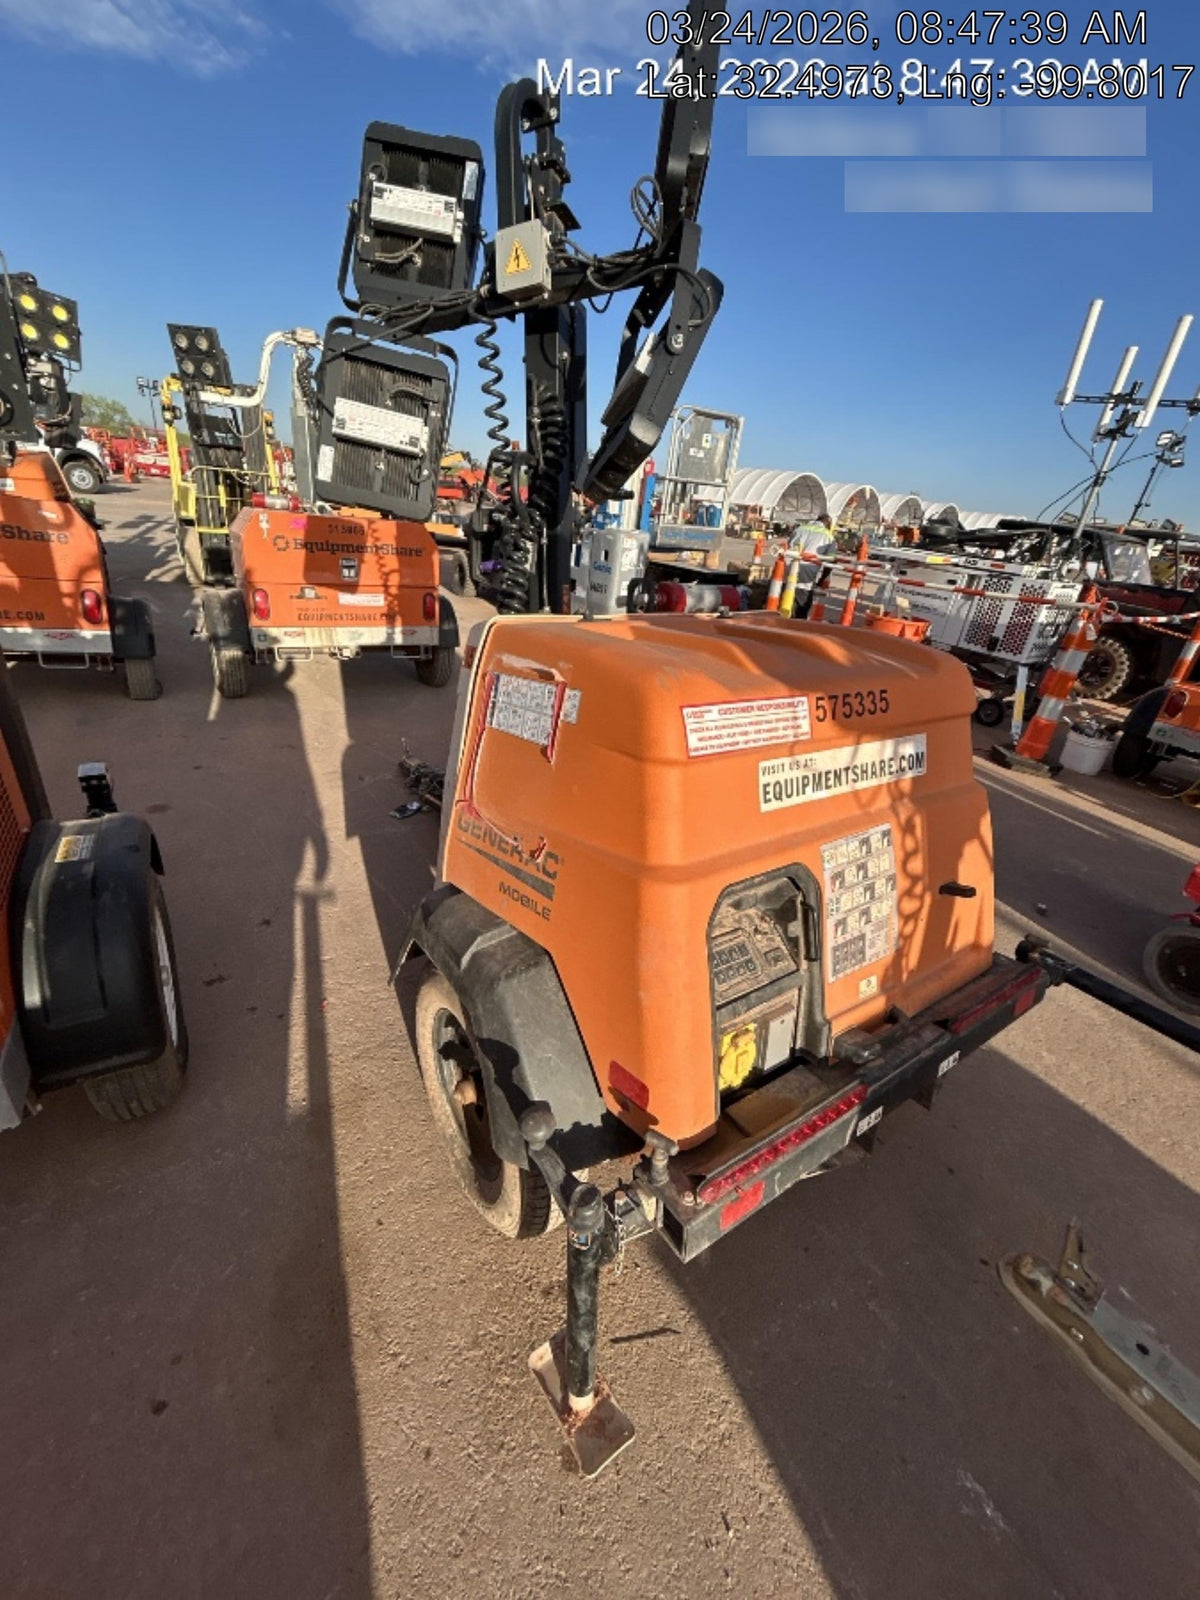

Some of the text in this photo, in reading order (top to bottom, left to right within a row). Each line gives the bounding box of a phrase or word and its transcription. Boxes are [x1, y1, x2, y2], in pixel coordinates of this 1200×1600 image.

[293, 538, 424, 560] EquipmentShare
[815, 689, 890, 723] 575335
[761, 762, 786, 777] VISIT
[788, 759, 801, 771] US
[762, 751, 925, 805] EQUIPMENTSHARE.COM
[498, 881, 553, 921] MOBILE
